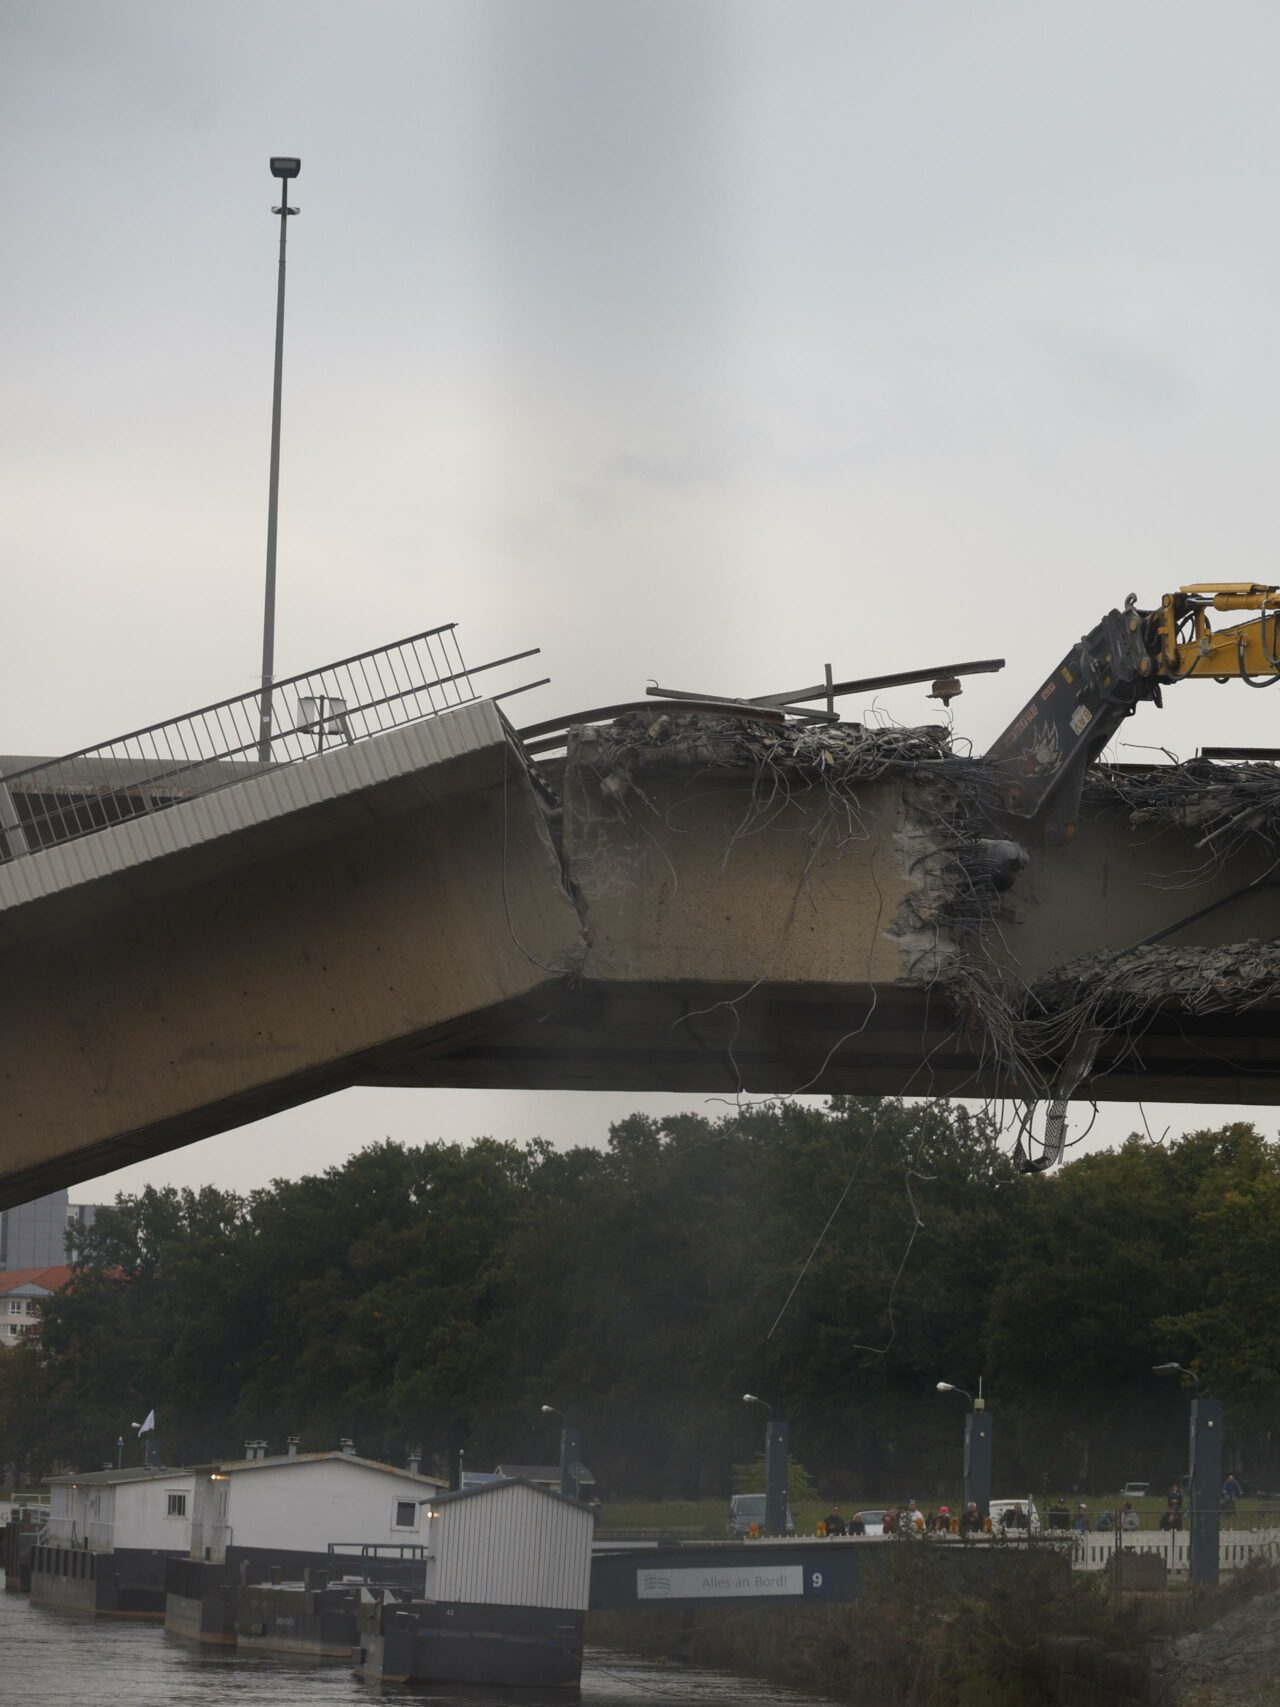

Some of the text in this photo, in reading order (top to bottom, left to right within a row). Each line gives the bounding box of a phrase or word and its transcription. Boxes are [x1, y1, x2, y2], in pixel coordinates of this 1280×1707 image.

[702, 1575, 788, 1589] Alles an Bord!
[812, 1572, 823, 1588] 9
